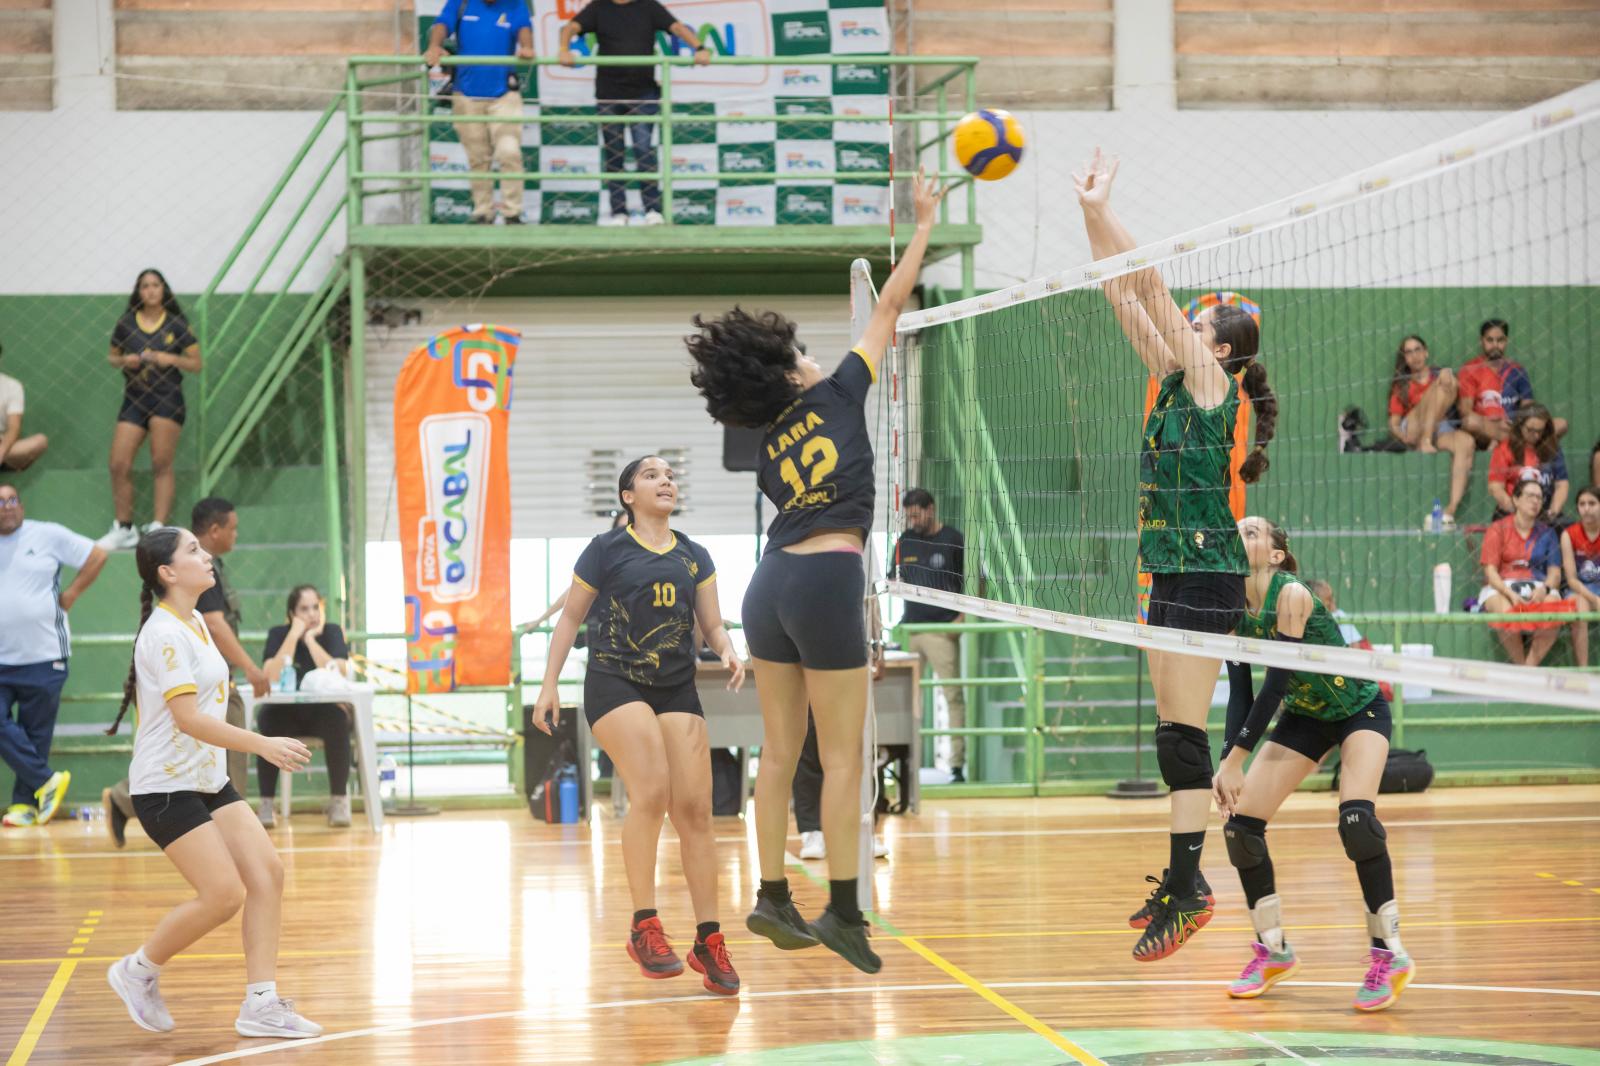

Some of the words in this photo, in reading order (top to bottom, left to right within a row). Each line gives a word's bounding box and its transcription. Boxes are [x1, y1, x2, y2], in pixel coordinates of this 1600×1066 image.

[767, 411, 824, 461] LARA
[780, 435, 839, 497] 12
[652, 582, 676, 607] 10
